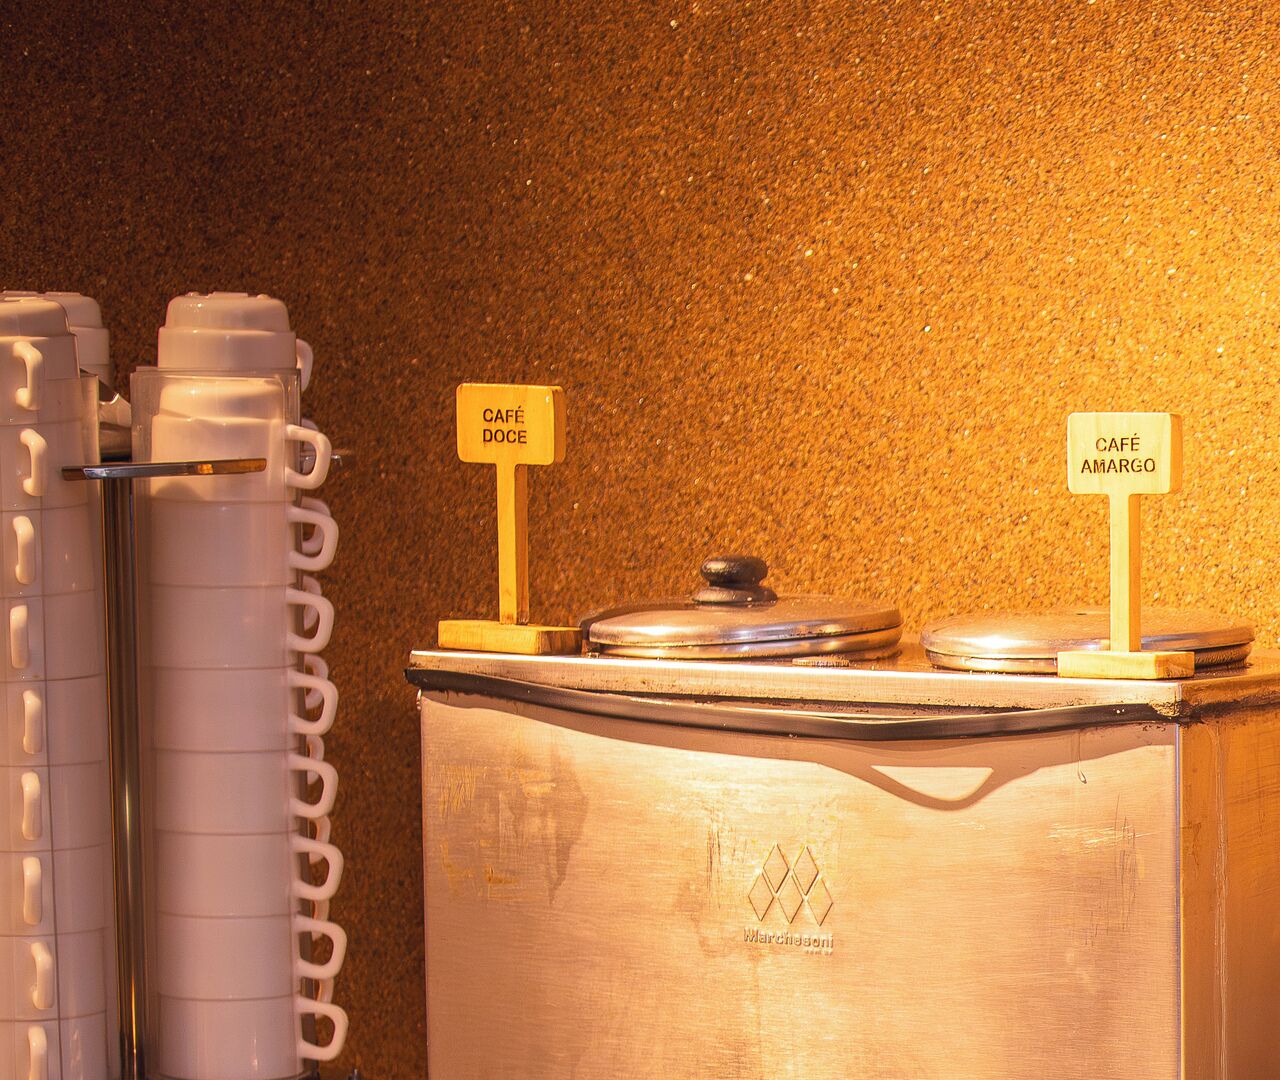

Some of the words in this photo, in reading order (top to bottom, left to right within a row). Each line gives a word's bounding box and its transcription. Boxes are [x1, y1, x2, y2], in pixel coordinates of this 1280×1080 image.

[482, 405, 525, 424] CAFÉ
[482, 428, 528, 445] DOCE
[1095, 432, 1141, 452] CAFÉ
[1080, 457, 1156, 474] AMARGO
